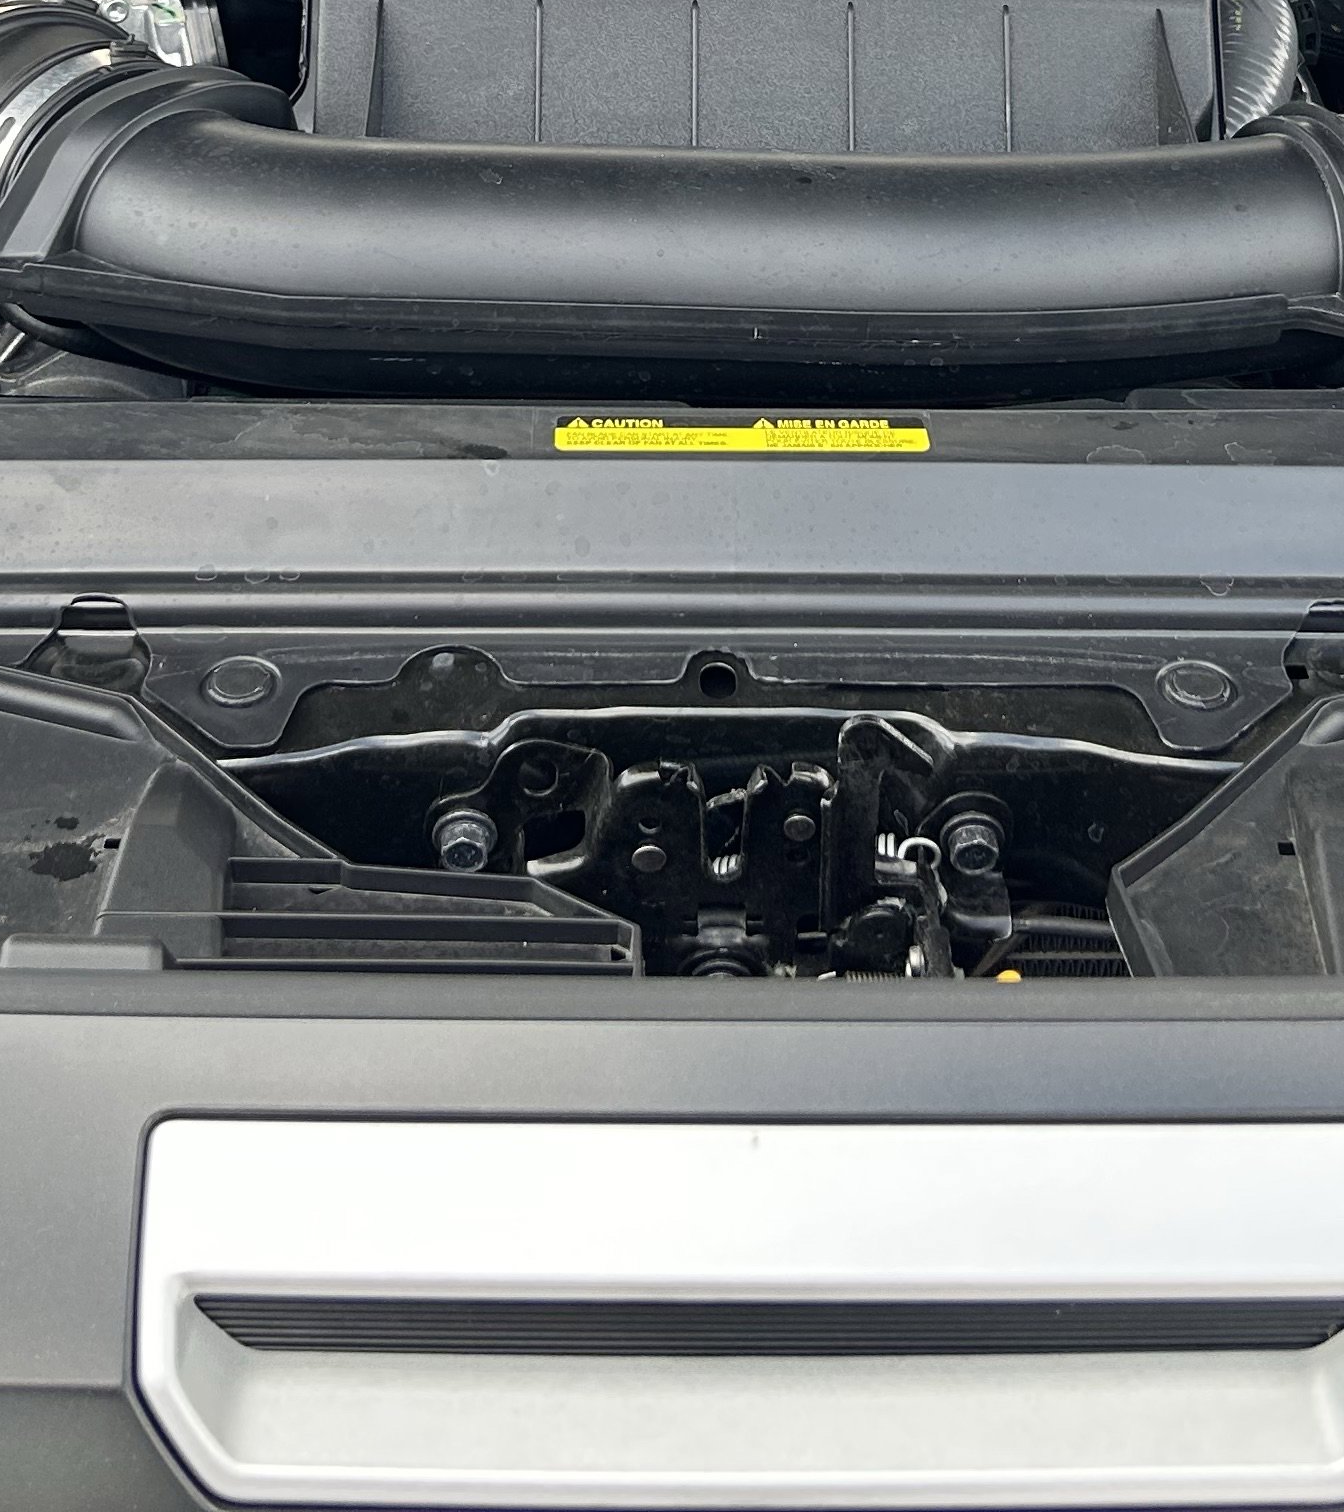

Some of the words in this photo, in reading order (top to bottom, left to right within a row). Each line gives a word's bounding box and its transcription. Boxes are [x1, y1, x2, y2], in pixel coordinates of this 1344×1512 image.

[591, 418, 664, 428] CAUTION
[776, 419, 812, 428] MISE
[815, 419, 836, 428] EN
[837, 419, 891, 428] GARDE
